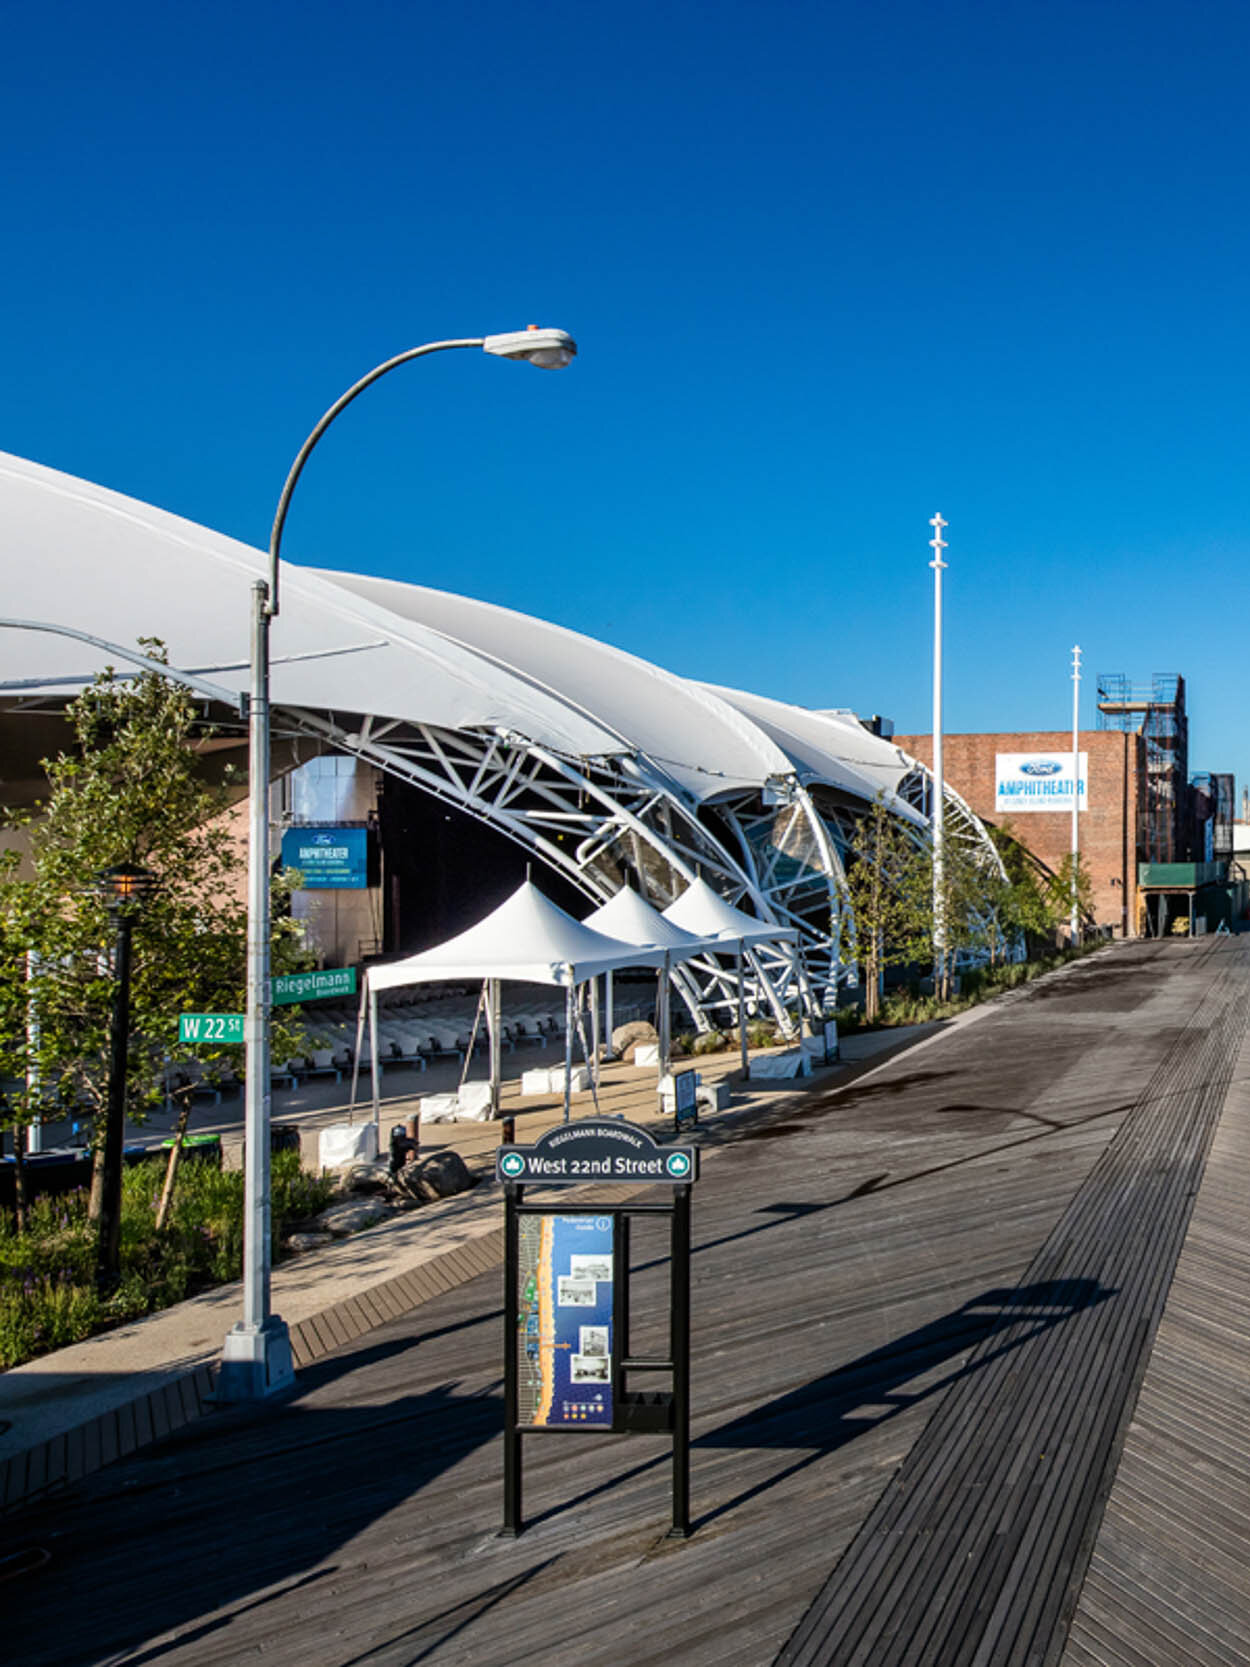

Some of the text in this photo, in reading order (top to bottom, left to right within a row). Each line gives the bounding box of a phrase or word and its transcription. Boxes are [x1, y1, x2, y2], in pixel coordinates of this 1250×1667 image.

[276, 973, 351, 994] Riegelmann
[184, 1018, 200, 1039] W
[204, 1018, 225, 1039] 22
[548, 1128, 643, 1148] RIEGELMANN BOARDWALK
[528, 1156, 663, 1174] West 22nd Street
